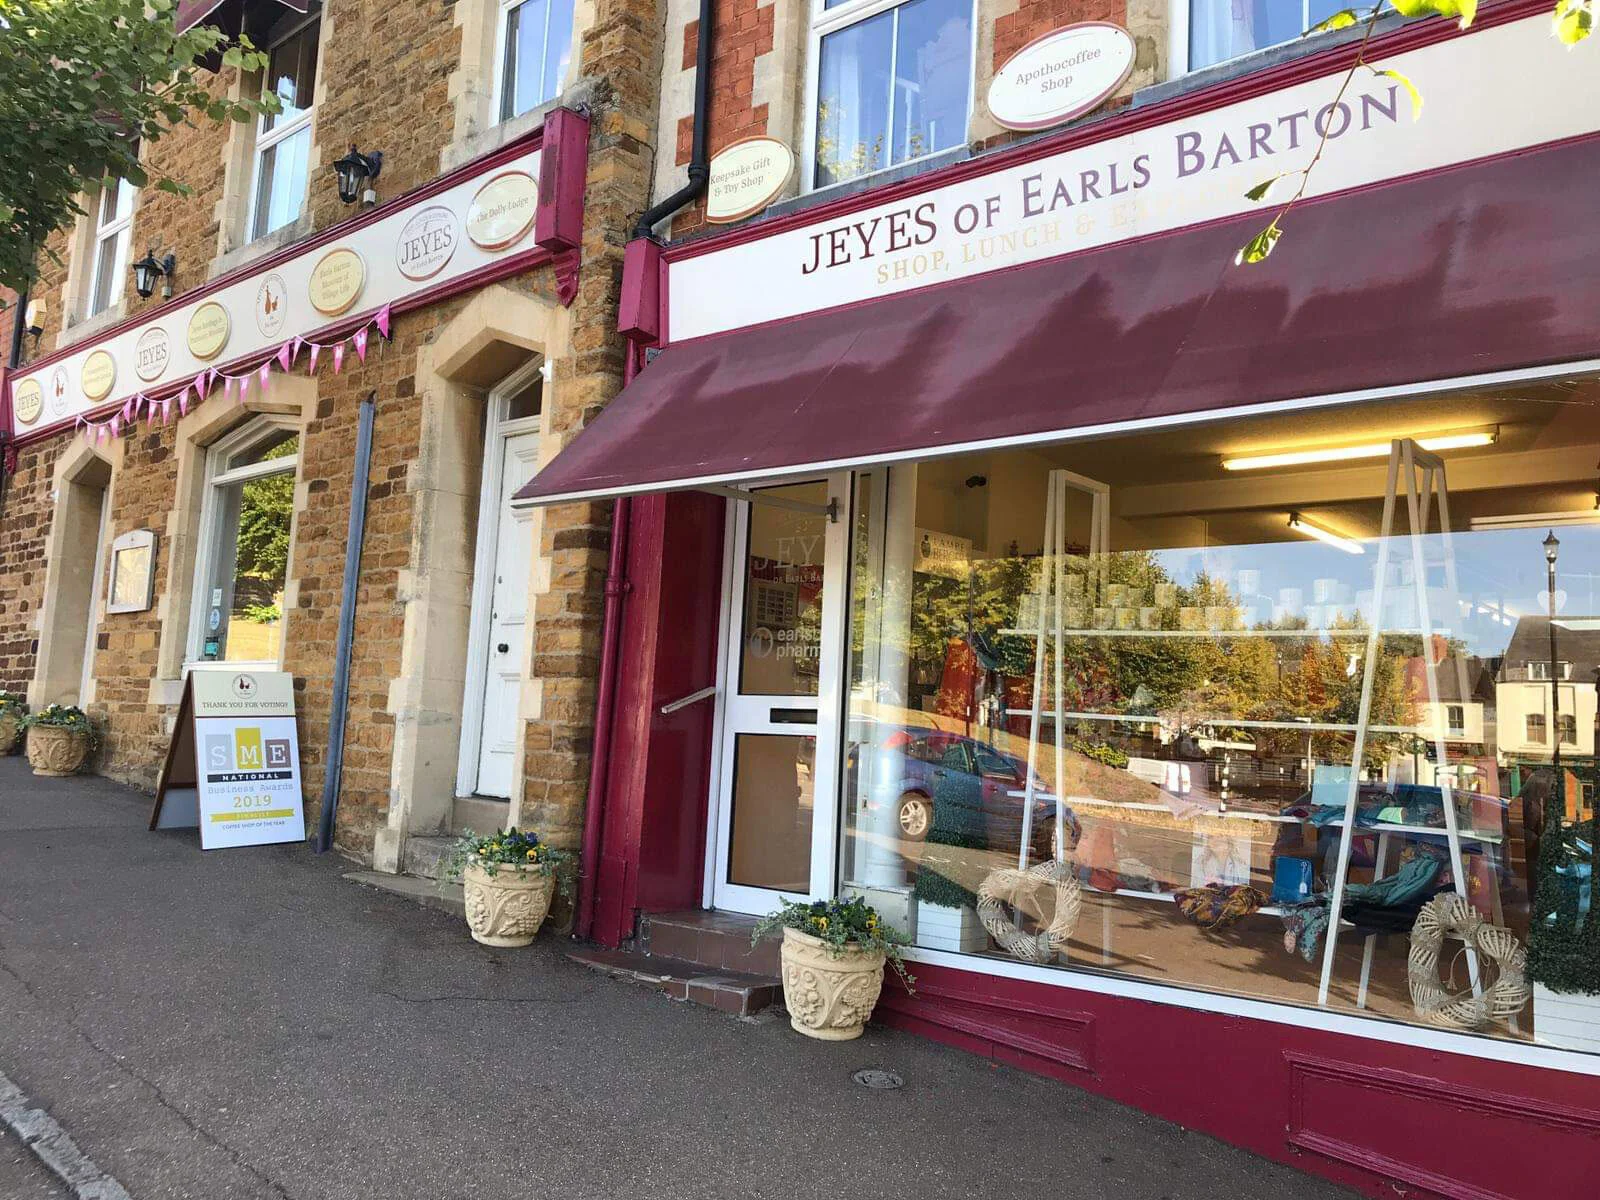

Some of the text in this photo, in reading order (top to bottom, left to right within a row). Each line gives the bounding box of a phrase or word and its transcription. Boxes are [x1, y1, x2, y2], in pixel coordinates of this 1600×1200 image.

[1015, 47, 1101, 85] Apothocoffee
[1040, 74, 1073, 93] Shop
[710, 156, 771, 185] Keepsake Gift
[801, 202, 937, 275] JEYES
[953, 195, 1001, 234] OF
[1022, 154, 1151, 218] EARLS
[1175, 85, 1398, 178] BARTON
[714, 174, 764, 197] & Toy Shop
[508, 196, 529, 210] Lodge
[401, 224, 453, 265] JEYES
[876, 213, 1097, 285] SHOP, LUNCH &
[137, 342, 168, 369] JEYES
[754, 534, 825, 570] JEY
[202, 701, 228, 709] THANK
[229, 701, 243, 709] YOU
[245, 701, 259, 709] FOR
[208, 782, 294, 794] Business Awards
[222, 773, 279, 781] NATIONAL
[233, 794, 272, 808] 2019
